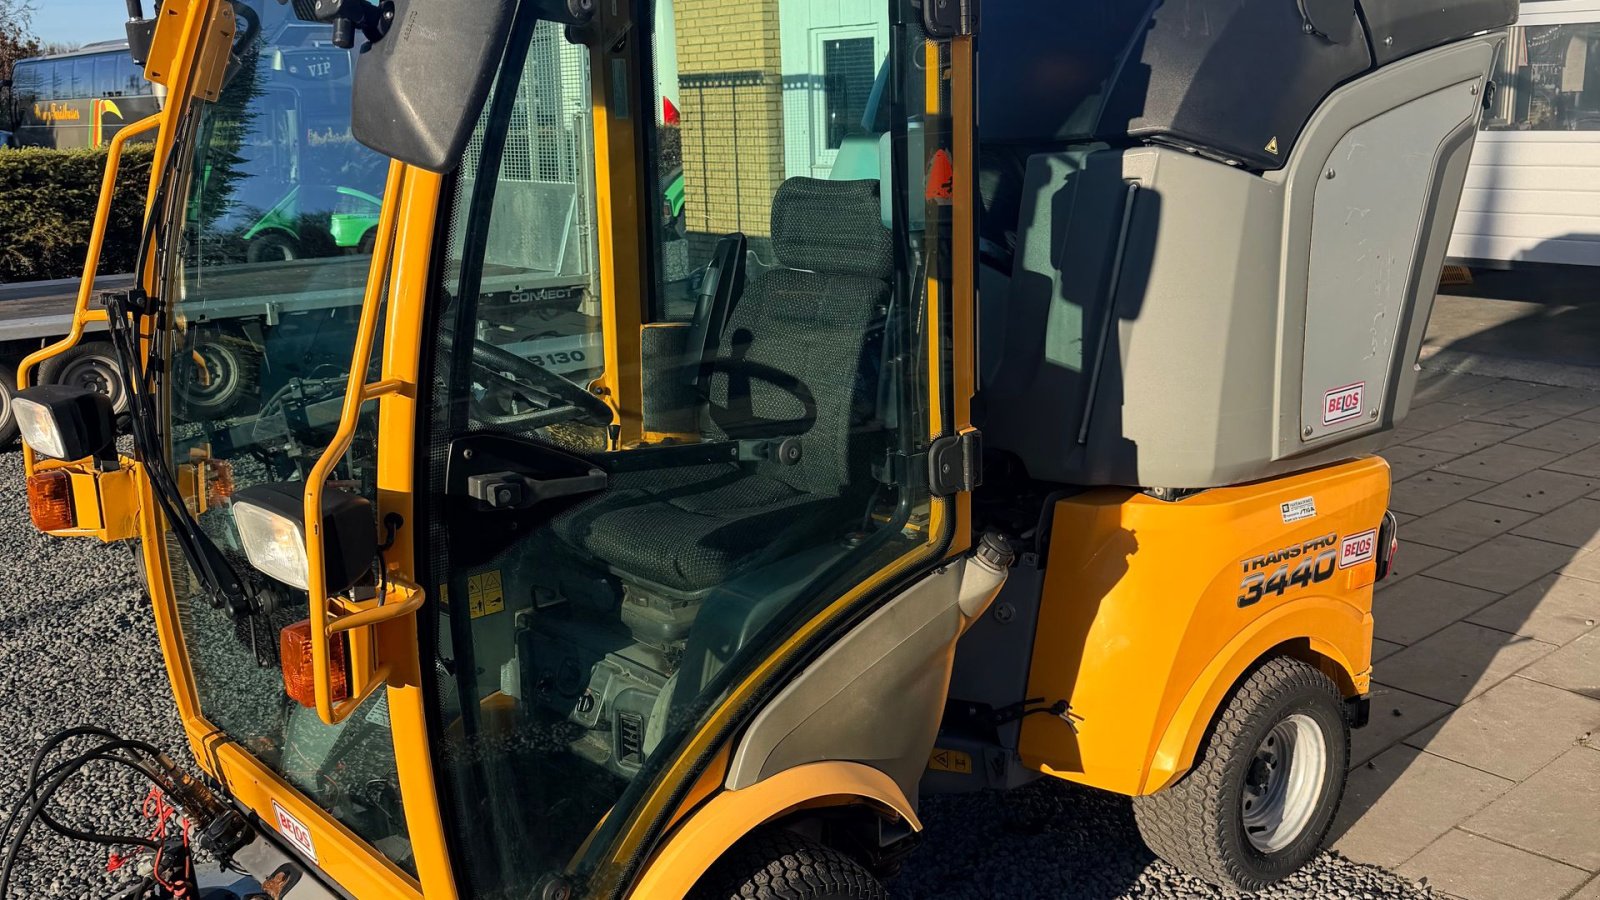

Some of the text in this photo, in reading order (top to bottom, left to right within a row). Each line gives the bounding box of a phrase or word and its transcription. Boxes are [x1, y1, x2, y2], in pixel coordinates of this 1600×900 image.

[308, 61, 331, 77] VIP
[510, 289, 572, 303] CONNECT
[1328, 392, 1359, 413] BELOS
[1344, 538, 1371, 557] BELOS
[1237, 548, 1336, 608] 3440
[280, 812, 311, 851] BELOS
